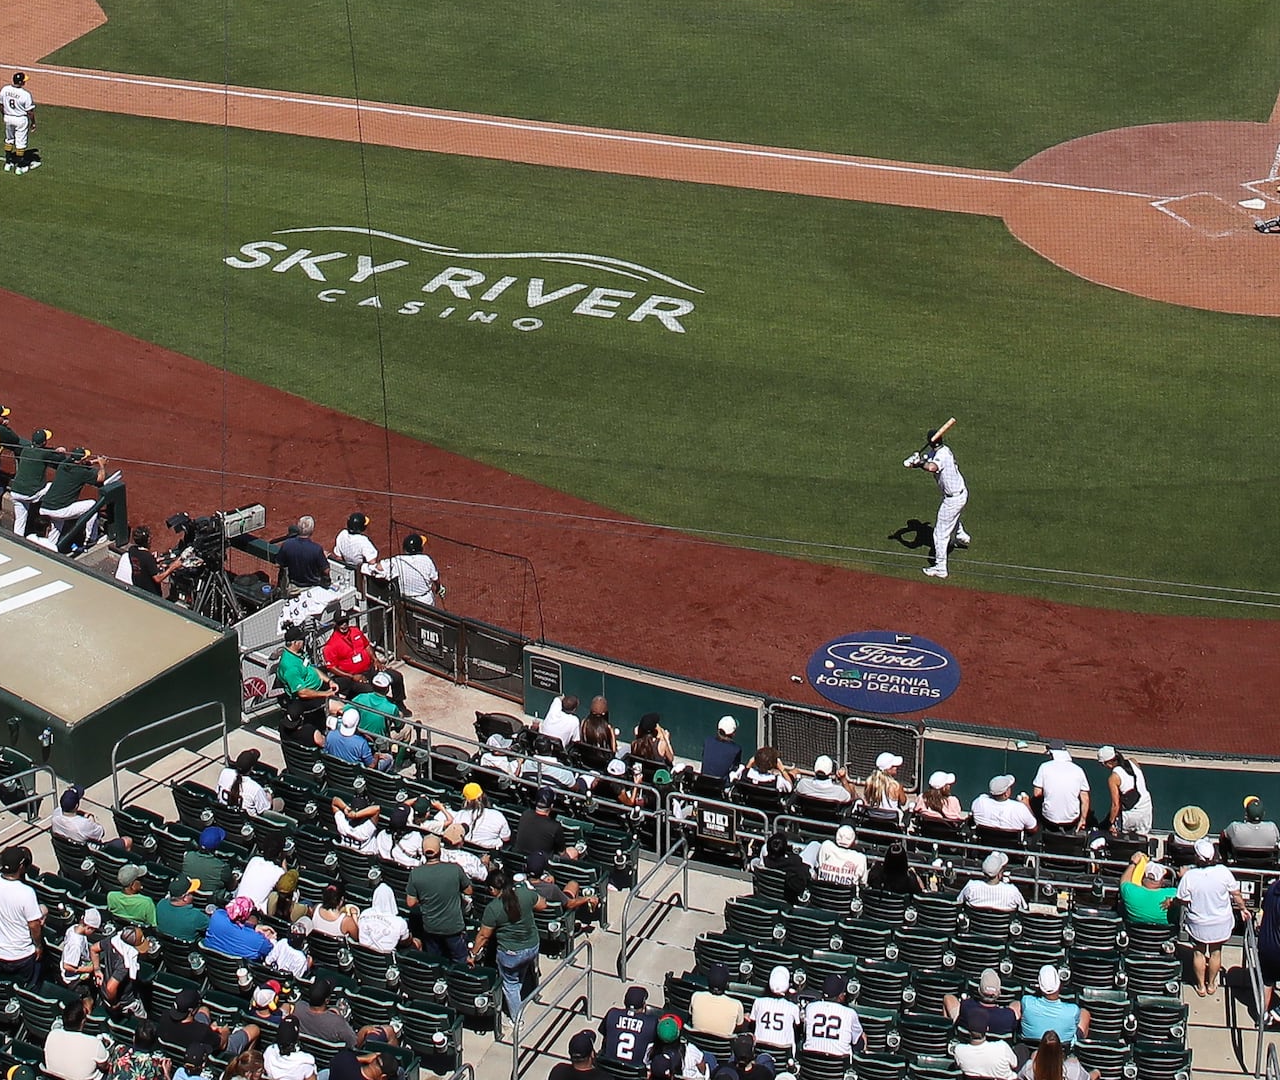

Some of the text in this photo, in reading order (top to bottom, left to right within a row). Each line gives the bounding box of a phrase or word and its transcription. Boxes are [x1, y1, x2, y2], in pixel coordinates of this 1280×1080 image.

[225, 241, 695, 333] SKY RIVER
[318, 289, 544, 332] CASINO
[849, 645, 924, 668] Ford
[816, 674, 941, 698] FORD DEALERS
[833, 669, 929, 687] CIFORNIA
[616, 1016, 643, 1032] JETER
[760, 1012, 784, 1031] 45
[812, 1014, 841, 1040] 22
[616, 1032, 635, 1060] 2
